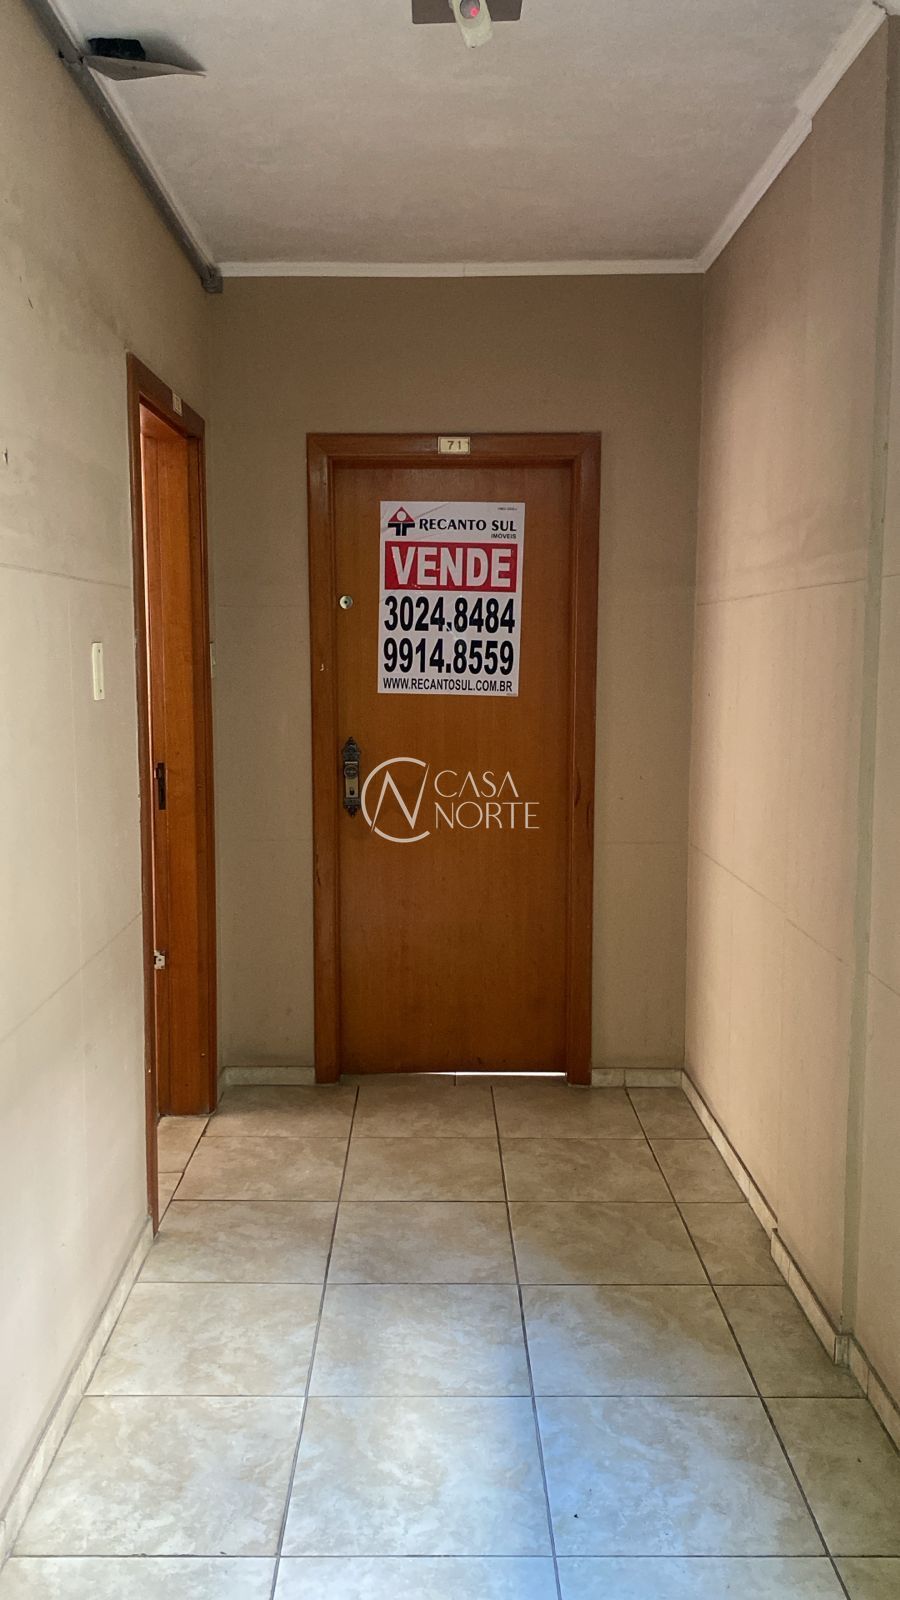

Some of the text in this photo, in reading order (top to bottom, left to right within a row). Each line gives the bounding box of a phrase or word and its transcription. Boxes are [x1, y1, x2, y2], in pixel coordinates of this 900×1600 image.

[447, 440, 462, 450] 71
[419, 518, 517, 532] RECANTO SUL
[391, 546, 512, 588] VENDE
[383, 637, 514, 676] 9914.8559
[383, 677, 513, 692] WWW.RECANTOSUL.COM.BR
